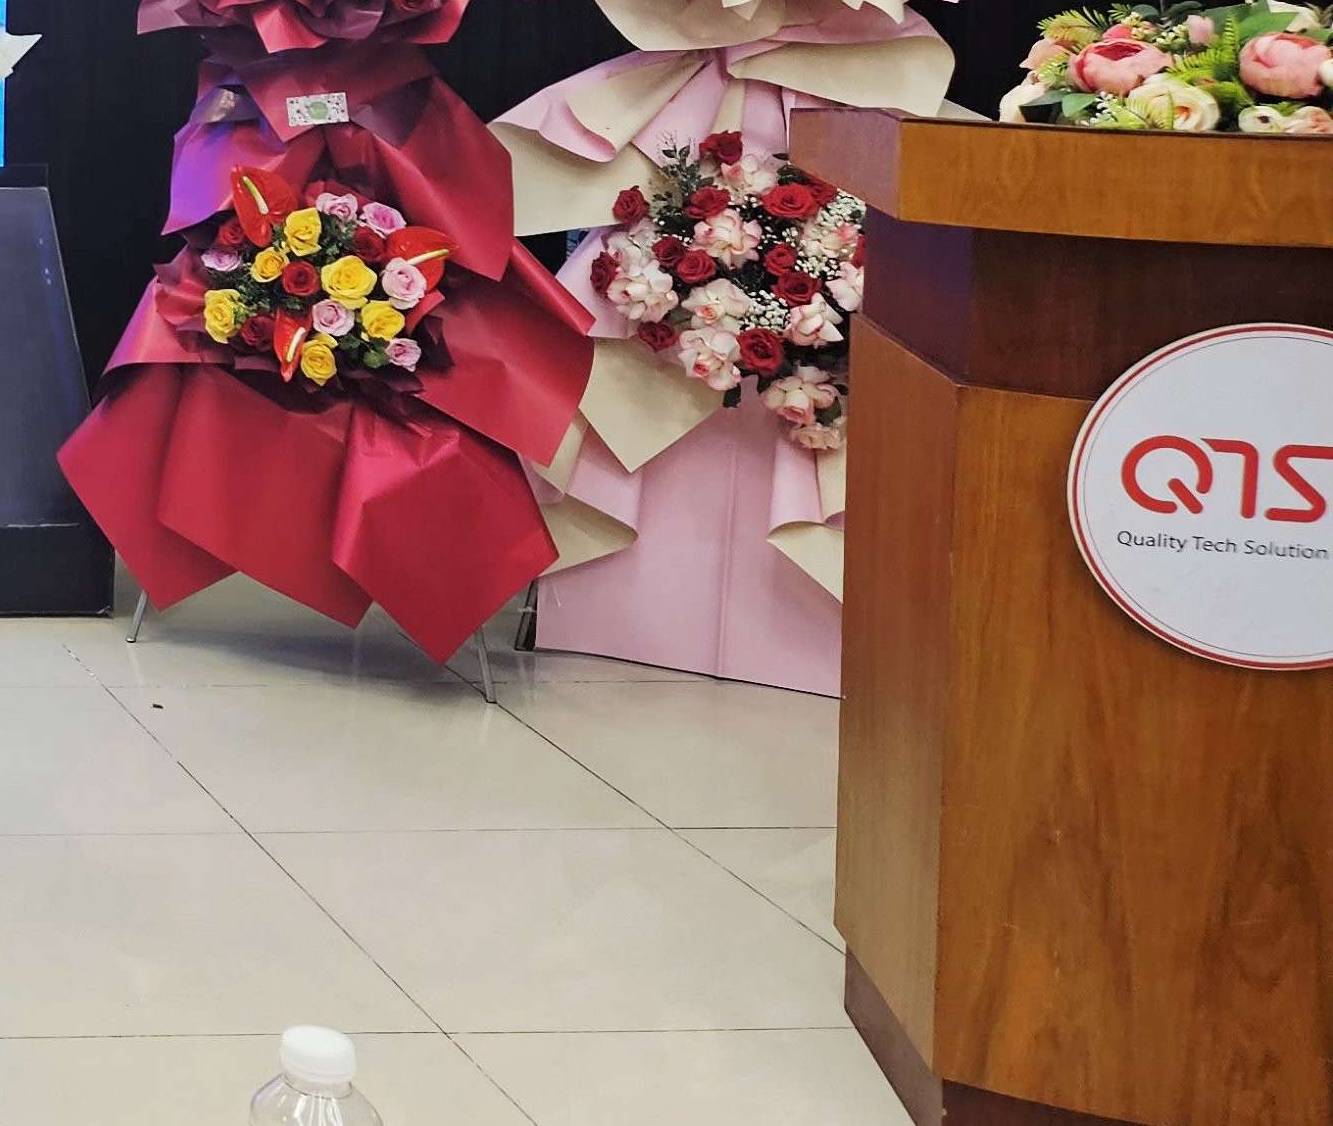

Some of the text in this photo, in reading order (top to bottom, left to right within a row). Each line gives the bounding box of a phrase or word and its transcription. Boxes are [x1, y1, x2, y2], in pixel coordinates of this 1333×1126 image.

[1117, 530, 1329, 560] Quality Tech Solution
